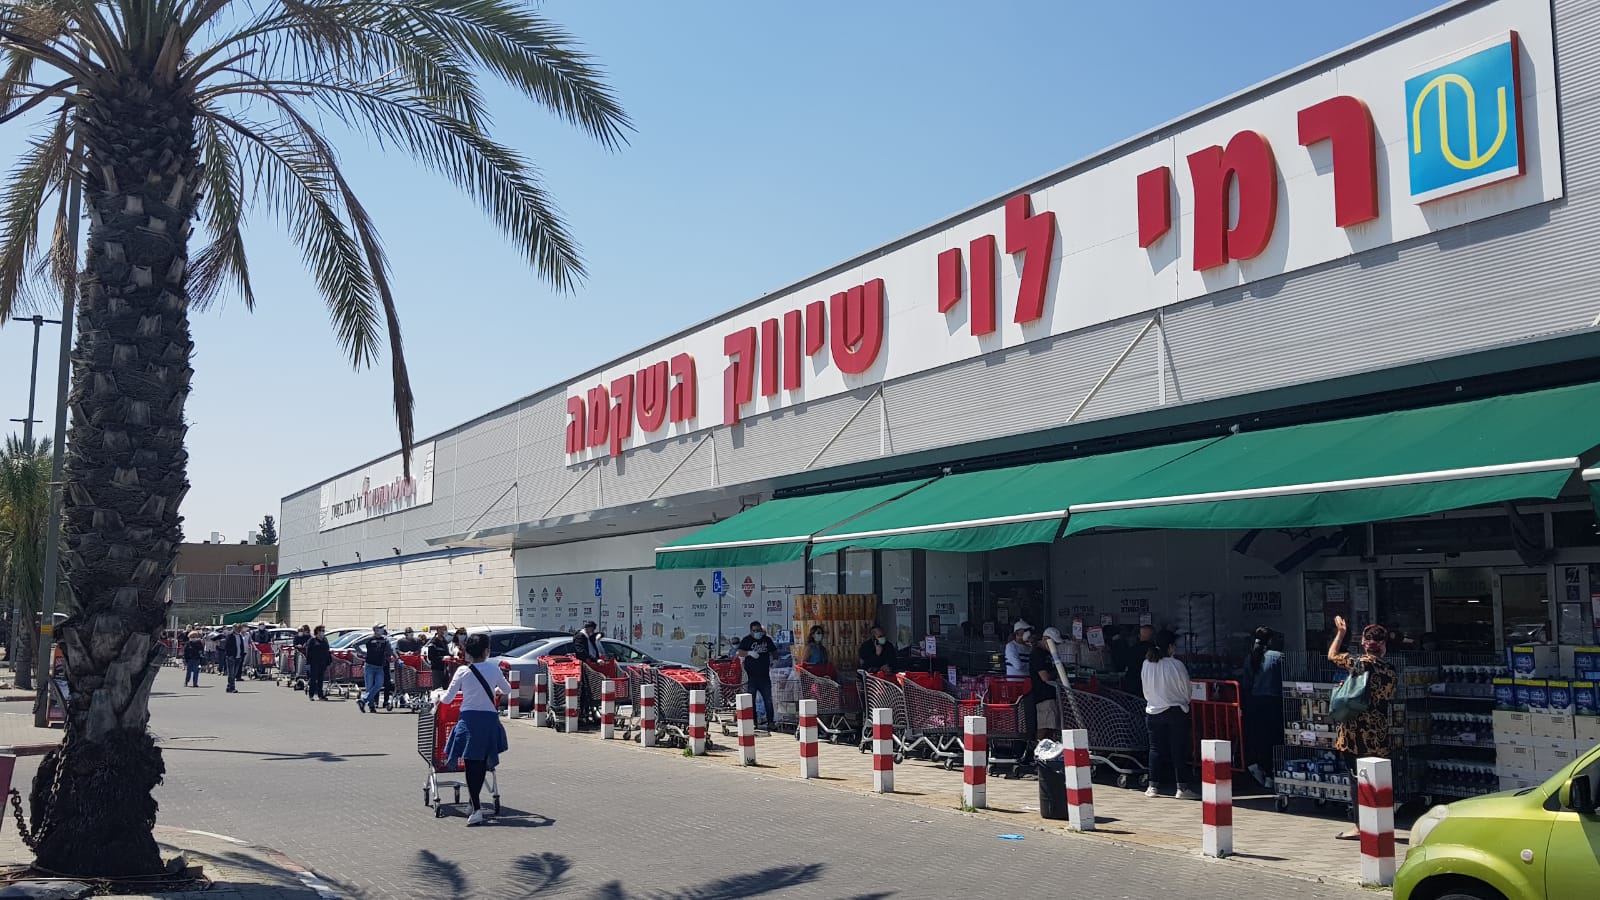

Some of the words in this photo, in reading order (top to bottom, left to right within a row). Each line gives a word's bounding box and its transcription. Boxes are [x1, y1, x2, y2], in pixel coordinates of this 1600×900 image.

[1137, 95, 1379, 271] רמי
[937, 194, 1056, 337] לוי
[565, 352, 697, 457] השקמה
[723, 278, 884, 426] שיווק
